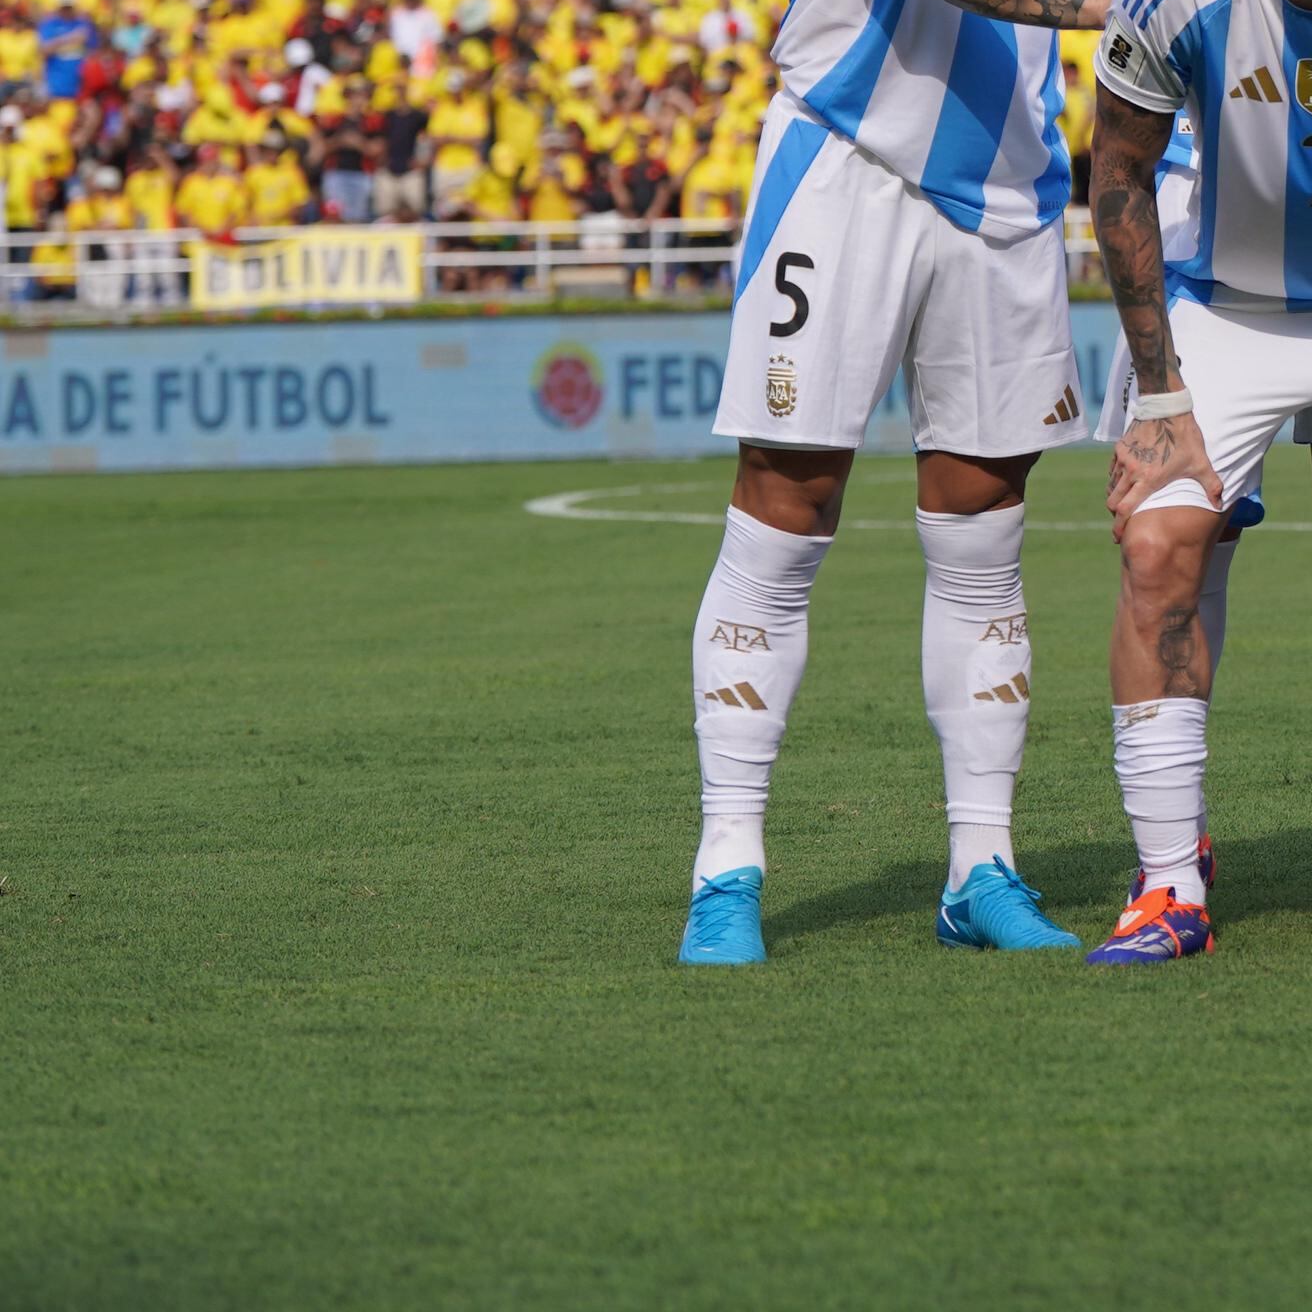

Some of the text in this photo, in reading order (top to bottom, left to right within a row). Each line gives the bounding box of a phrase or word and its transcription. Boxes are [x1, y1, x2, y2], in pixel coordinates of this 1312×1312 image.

[769, 251, 815, 338] 5
[62, 372, 131, 434] DE
[155, 351, 389, 433] FÚTBOL
[769, 382, 788, 404] AFA
[710, 618, 772, 653] AFA
